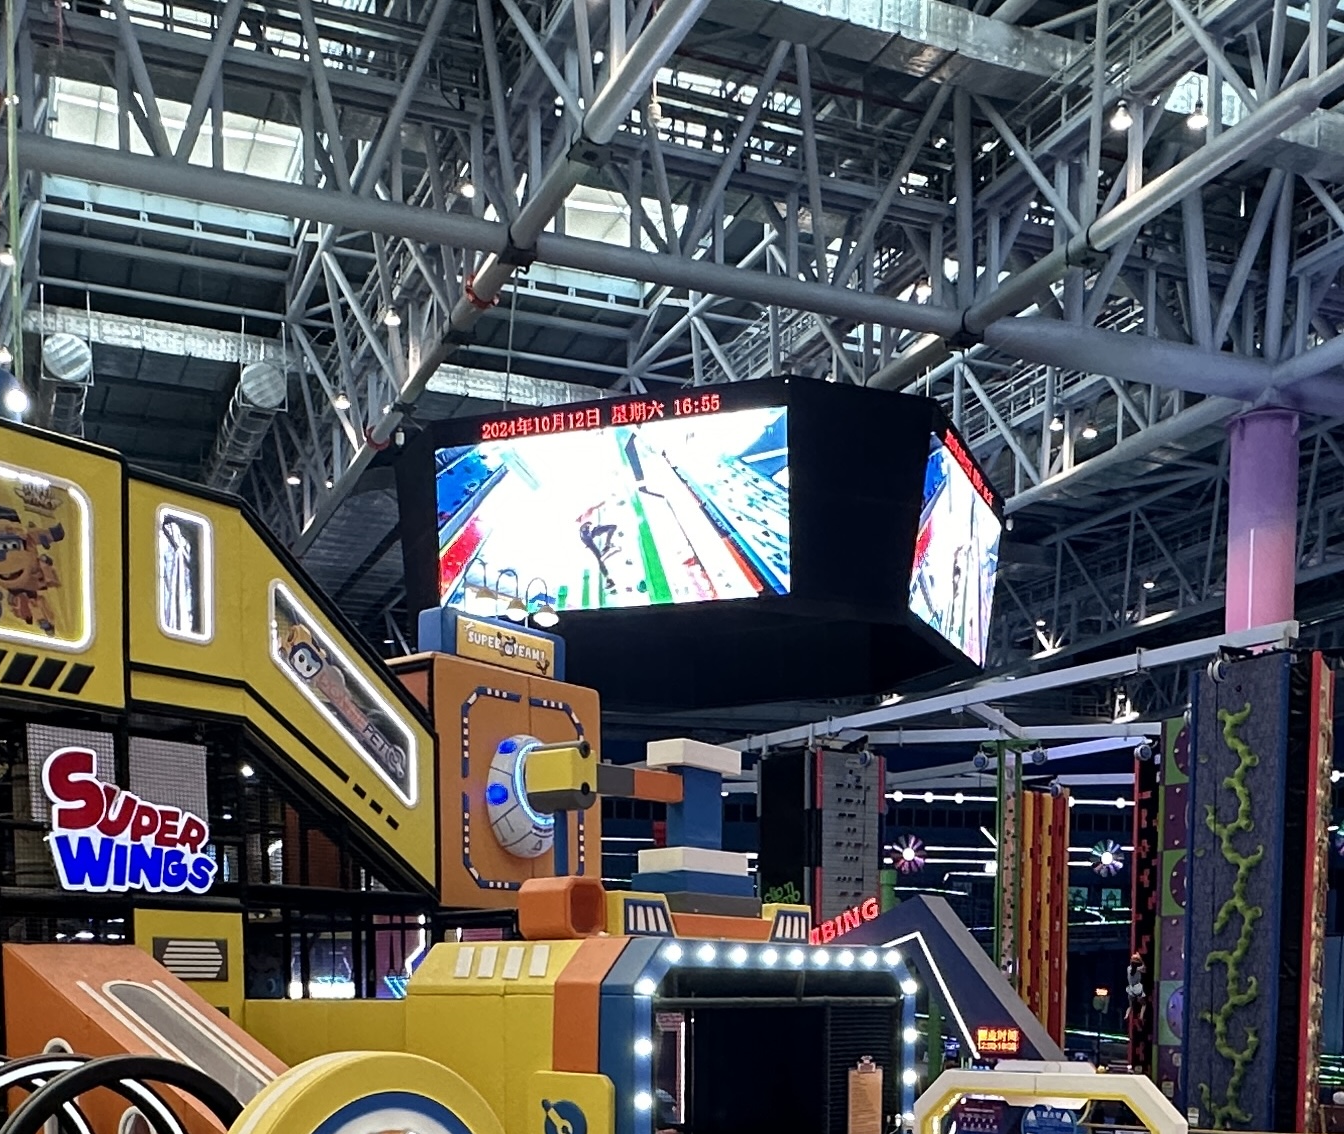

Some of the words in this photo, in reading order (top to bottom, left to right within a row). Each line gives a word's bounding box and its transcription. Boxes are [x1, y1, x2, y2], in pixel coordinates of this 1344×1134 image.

[482, 408, 601, 439] 2024年10月12日
[611, 400, 665, 424] 星期六
[467, 631, 501, 650] SUPER
[47, 750, 208, 855] SUPER
[53, 833, 216, 891] WINGS
